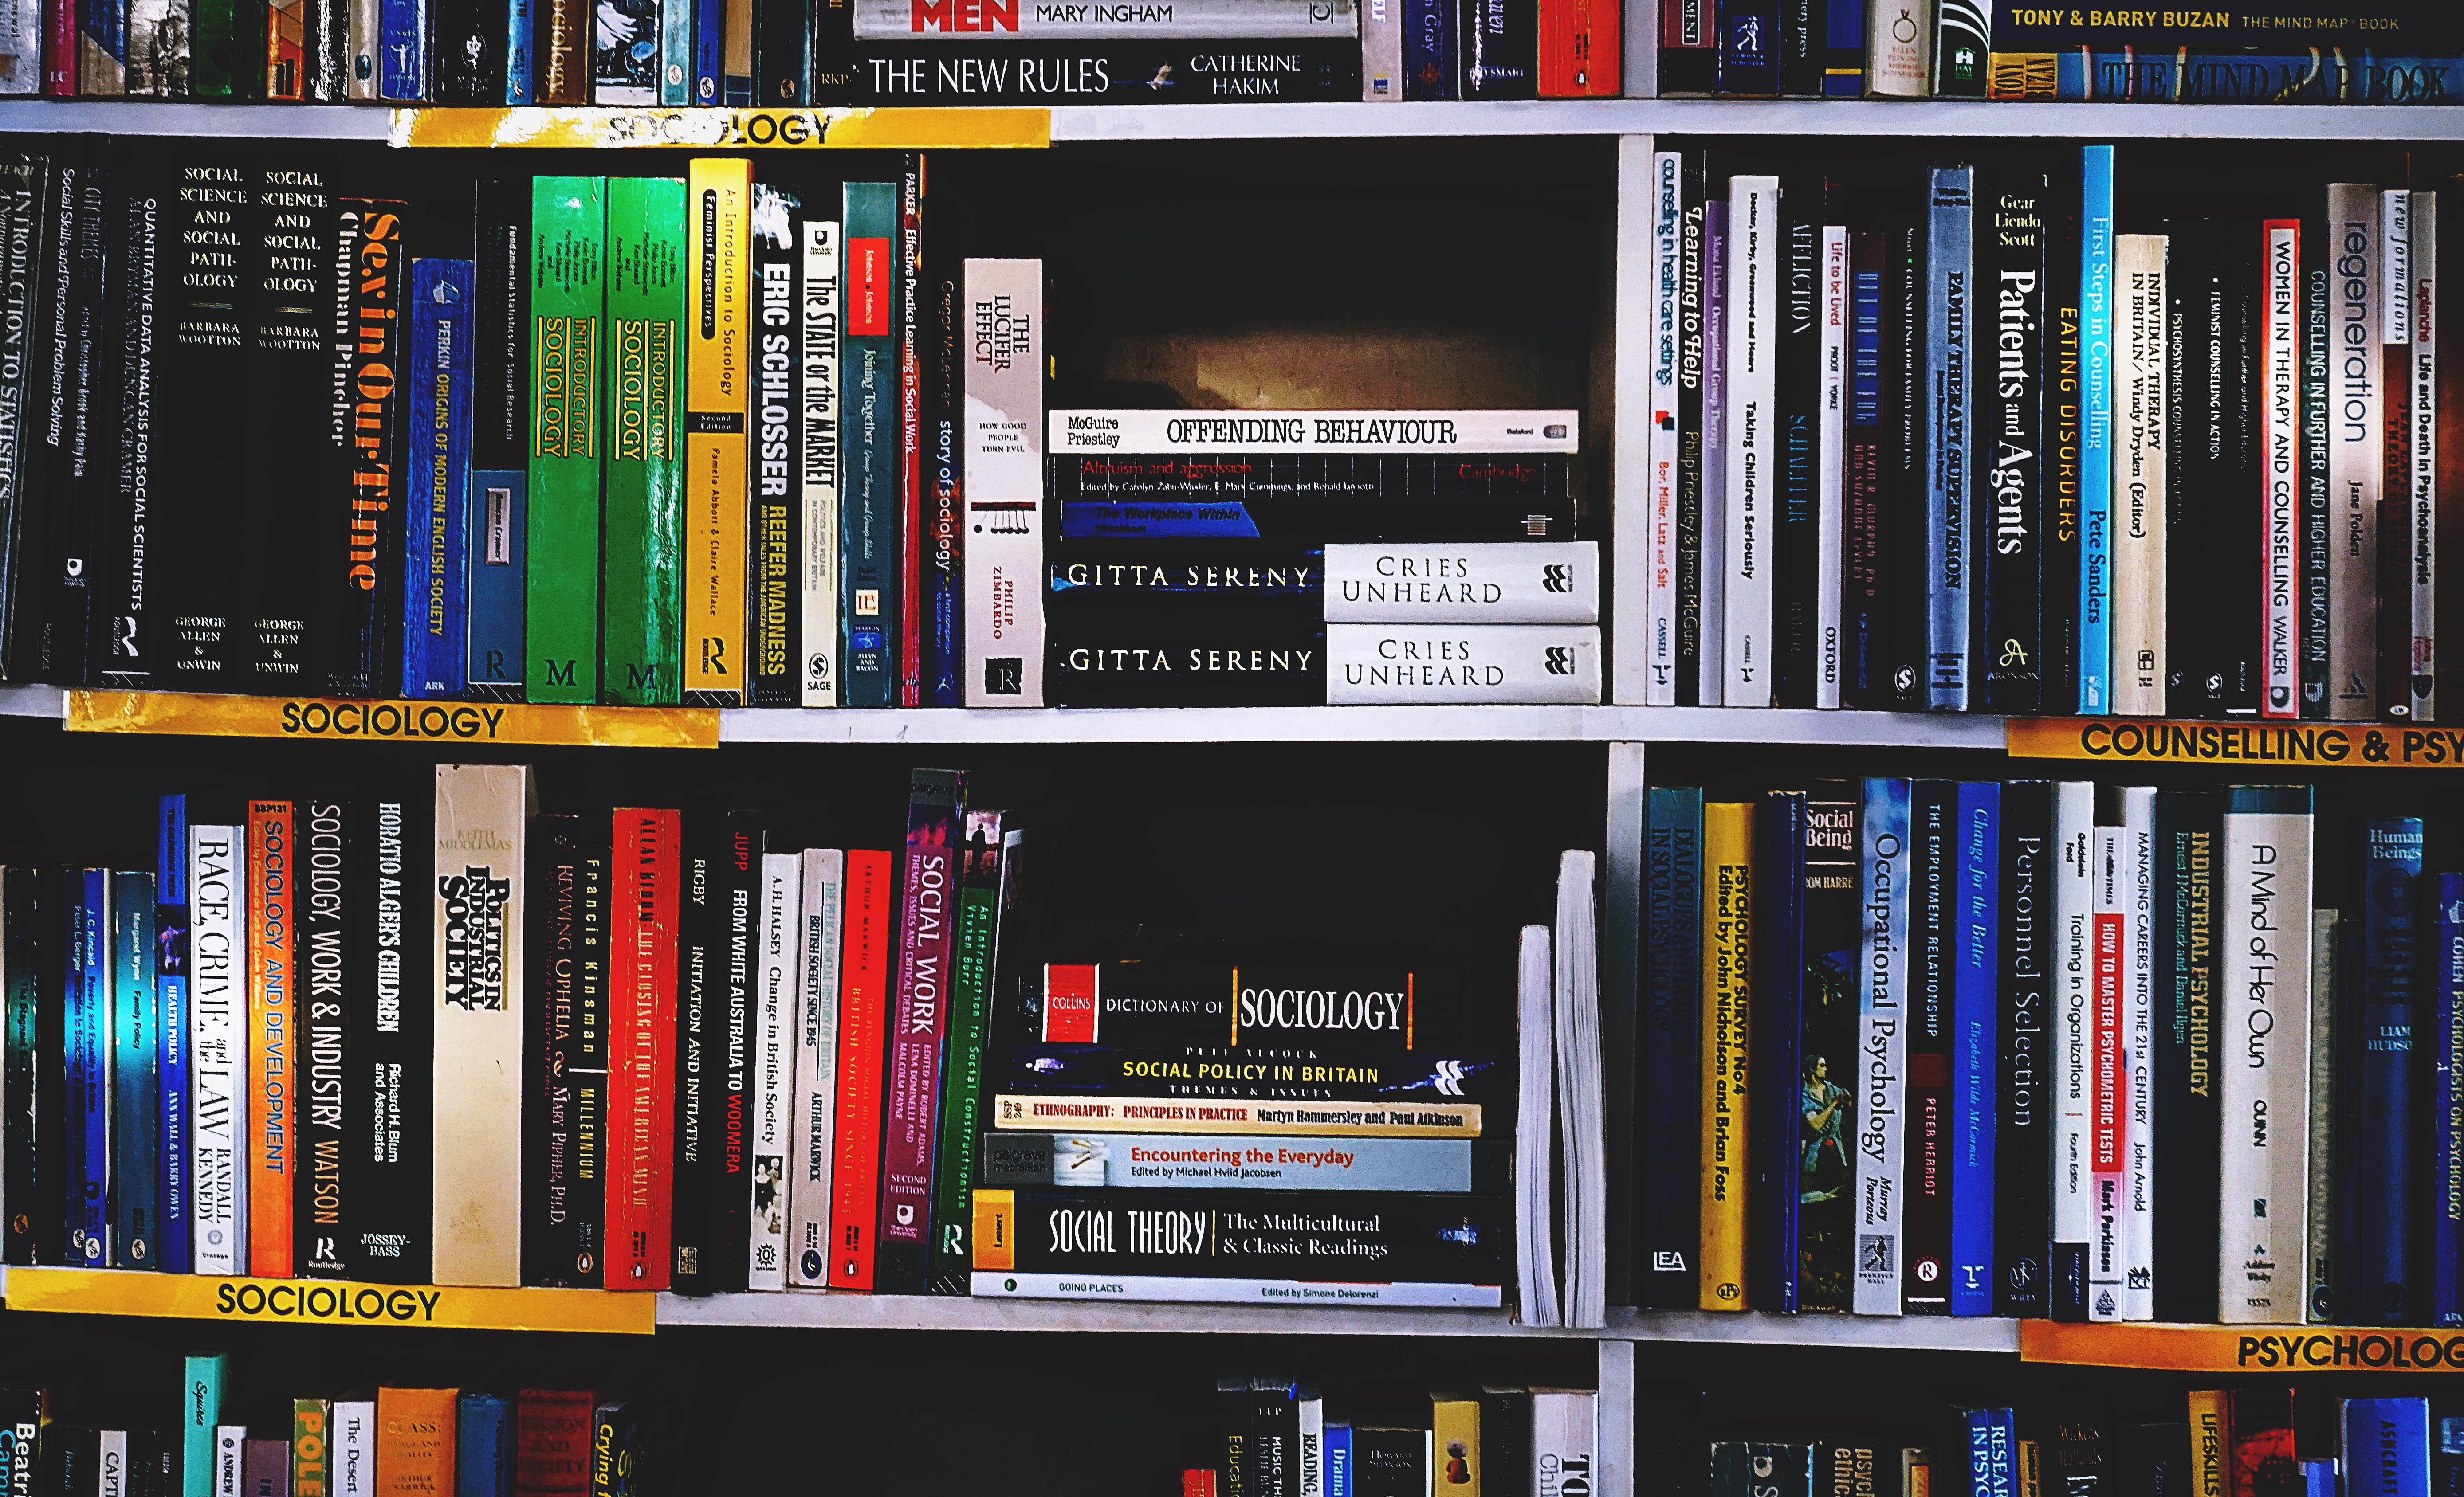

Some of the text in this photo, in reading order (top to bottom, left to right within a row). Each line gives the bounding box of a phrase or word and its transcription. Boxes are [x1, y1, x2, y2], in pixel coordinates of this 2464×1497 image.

[911, 0, 1019, 32] MEN
[1036, 4, 1173, 23] MARY INGHAM
[2012, 9, 2229, 27] TONY & BARRY BUZAN
[2243, 16, 2399, 30] THE MIND MAP BOOK
[869, 59, 1109, 93] THE NEW RULES
[1191, 55, 1300, 74] CATHERINE
[1213, 78, 1279, 95] HAKIM
[180, 189, 247, 204] SCIENCE
[185, 168, 243, 181] SOCIAL
[183, 231, 240, 245] SOCIAL
[194, 211, 230, 224] AND
[184, 274, 238, 287] OLOGY
[190, 252, 236, 266] PATH-
[508, 225, 517, 289] Fundamental
[703, 195, 716, 328] Feminist Perspectives
[720, 189, 736, 397] An Introduction to Sociology
[903, 173, 917, 453] PARKER Effective Practice Learning in Social Work
[1681, 207, 1702, 389] Learning to Help
[976, 302, 992, 366] EFFECT
[994, 295, 1011, 373] LUCIFER
[1013, 314, 1030, 354] THE
[2337, 221, 2372, 442] regeneration
[131, 198, 156, 611] QUANTITATIVE DATA ANALYSIS FOR SOCIAL SCIENTISTS
[544, 317, 563, 458] SOCIOLOGY
[573, 319, 586, 455] INTRODUCTORY
[1990, 270, 2036, 555] Patients and Agents
[1067, 432, 1120, 448] Priestley
[1068, 417, 1119, 430] McGuire
[1167, 419, 1457, 444] OFFENDING BEHAVIOUR
[2059, 307, 2077, 542] EATING DISORDERS
[2087, 217, 2108, 624] First Steps in Counselling Pete Sanders
[430, 320, 451, 636] PERKIN ORIGINS OF MODERN ENGLISH SOCIETY
[761, 263, 790, 675] ERIC SCHLOSSER REEFER MADNESS
[2273, 242, 2291, 675] WOMEN IN THERAPY AND COUNSELLING WALKER
[1741, 401, 1757, 580] Taking Children Seriously
[993, 566, 1002, 639] ZIMBARDO
[1070, 649, 1313, 671] GITTA SERENY
[1344, 665, 1505, 686] UNHEARD
[1379, 640, 1470, 661] CRIES
[1825, 626, 1836, 684] OXFORD
[808, 682, 831, 691] SAGE
[281, 702, 504, 738] SOCIOLOGY
[2081, 723, 2350, 762] COUNSELLING
[2362, 731, 2390, 763] &
[193, 839, 230, 1032] RACE, CRIME,
[912, 855, 944, 1035] SOCIAL WORK
[1926, 804, 1941, 1038] THE EMPLOYMENT RELATIONSHIP
[2014, 837, 2040, 1126] Personnel Selection
[2190, 832, 2209, 1097] INDUSTRIAL PSYCHOLOGY
[264, 820, 284, 1175] SOCIOLOGY AND DEVELOPMENT
[308, 805, 342, 1224] SOCIOLOGY, WORK & INDUSTRY WATSON
[726, 832, 749, 1174] JUPP FROM WHITE AUSTRALIA TO WOOMERA
[1106, 988, 1404, 1031] DICTIONARY OF SOCIOLOGY
[1861, 833, 1900, 1164] Occupational Psychology
[2067, 913, 2084, 1099] Training in Organizations
[1123, 1061, 1379, 1084] SOCIAL POLICY IN BRITAIN
[199, 1068, 230, 1141] LAW
[199, 1148, 213, 1224] KENNEDY
[216, 1149, 231, 1223] RANDALL
[1131, 1146, 1354, 1170] Encountering the Everyday
[1049, 1209, 1208, 1256] SOCIAL THEORY
[1223, 1213, 1380, 1232] The Multicultural
[1223, 1235, 1388, 1260] & Classic Readings
[217, 1283, 441, 1321] SOCIOLOGY
[1059, 1283, 1124, 1294] GOING PLACES
[195, 1380, 208, 1426] Squires
